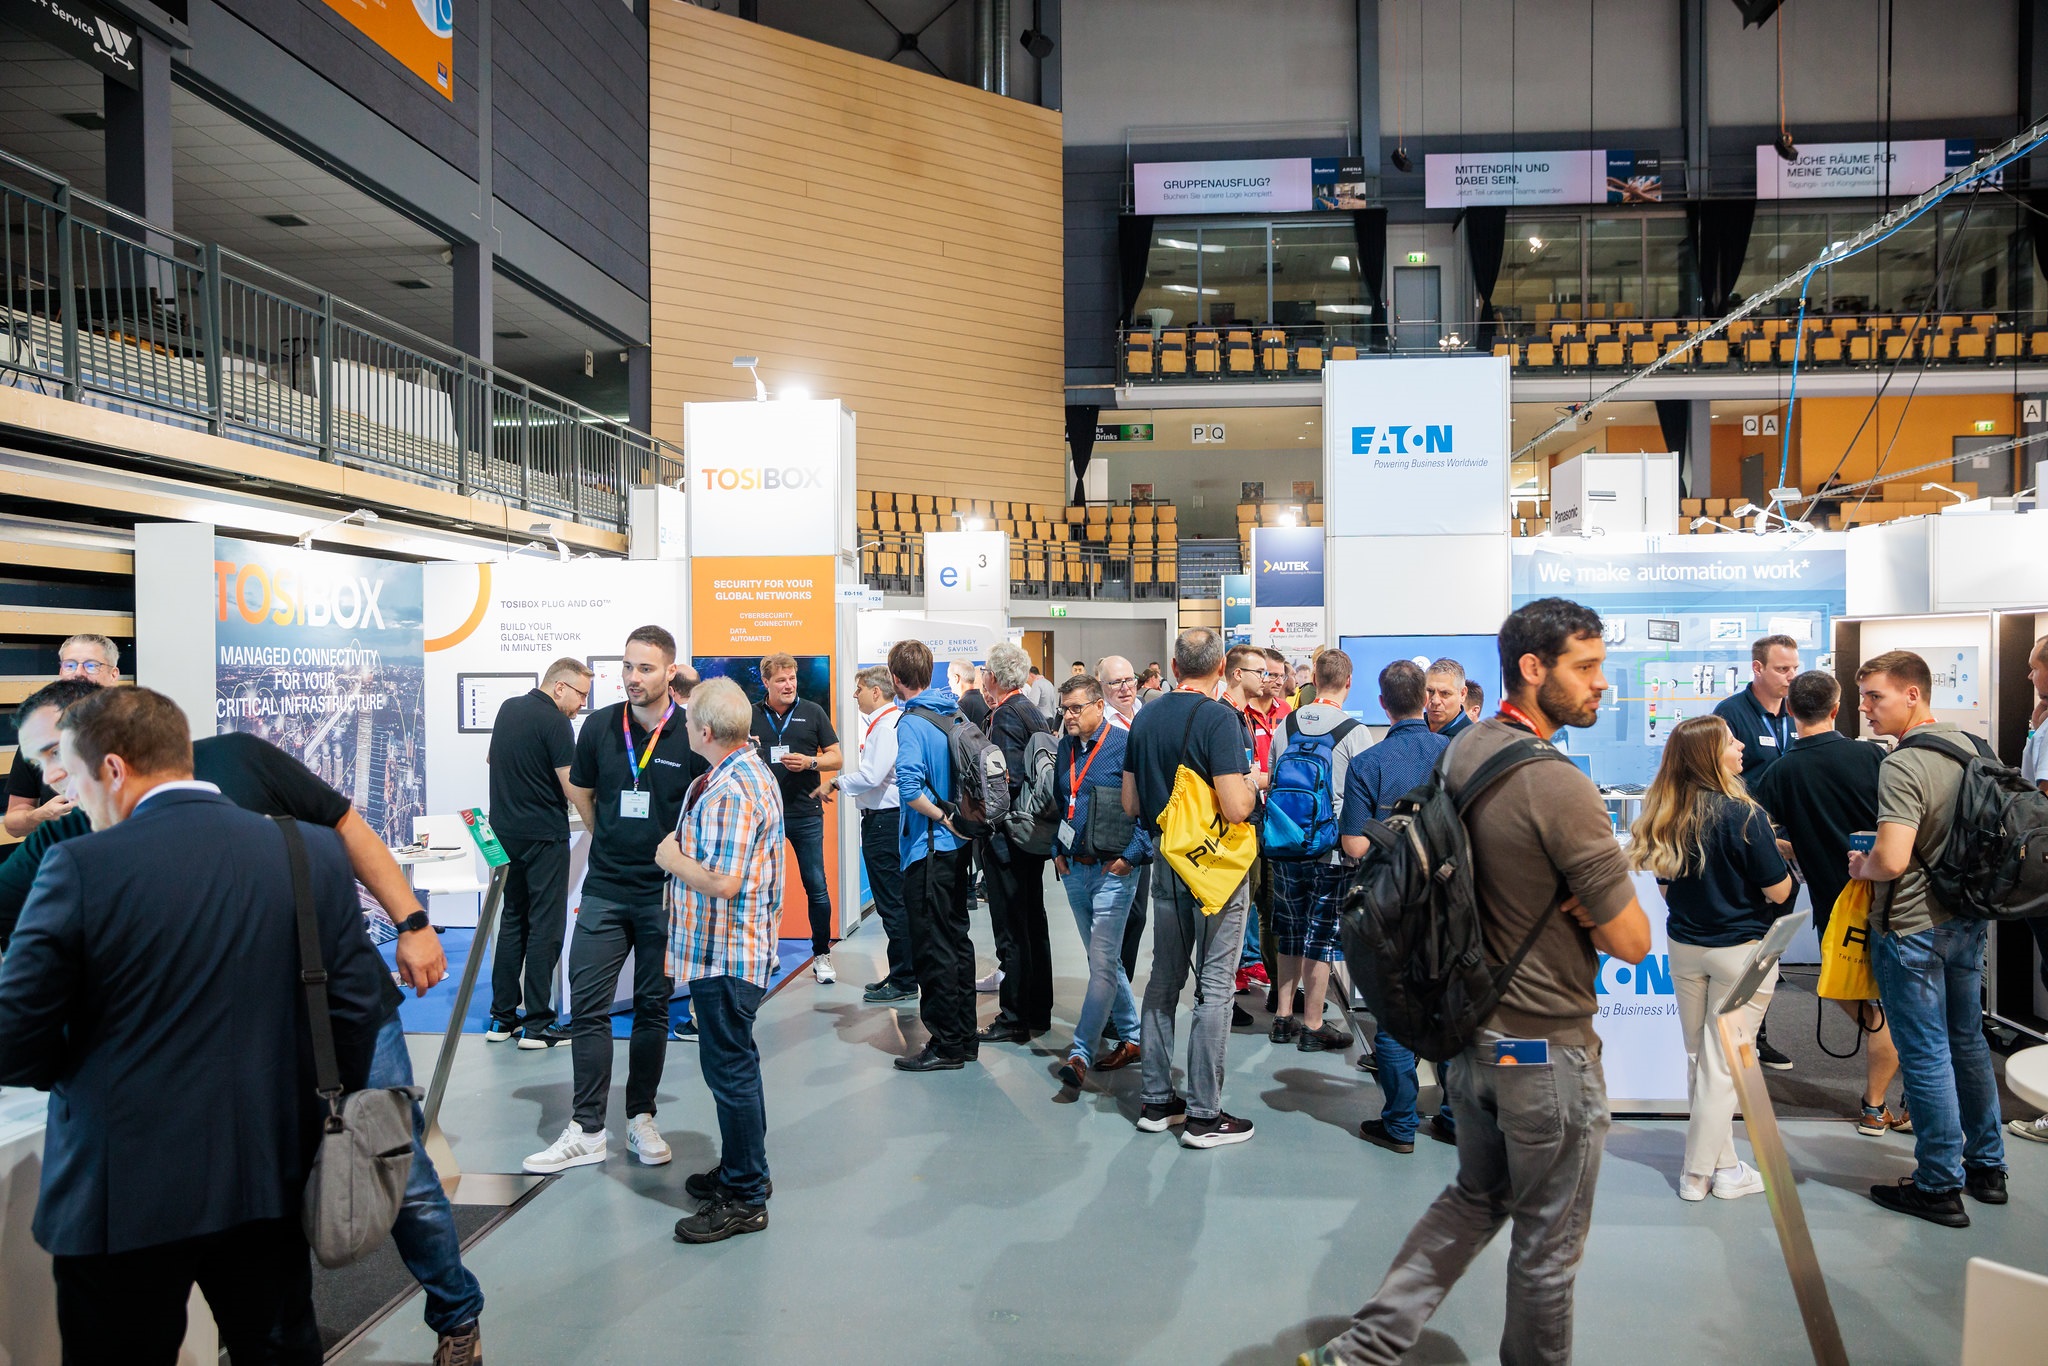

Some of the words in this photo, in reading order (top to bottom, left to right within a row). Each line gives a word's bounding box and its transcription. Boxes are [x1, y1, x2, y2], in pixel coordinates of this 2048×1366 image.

[51, 2, 95, 37] Service
[1829, 153, 1870, 164] RÄUME
[1455, 164, 1522, 174] MITTENDRIN
[1525, 163, 1550, 173] UND
[1787, 167, 1822, 177] MEINE
[1825, 166, 1875, 176] TAGUNG!
[1163, 177, 1271, 190] GRUPPENAUSFLUG?
[1455, 176, 1488, 185] DABEI
[1491, 175, 1520, 185] SEIN.
[1163, 191, 1189, 201] Buchen
[1190, 191, 1201, 199] Sie
[1225, 190, 1243, 200] Loge
[2026, 404, 2039, 418] A
[1744, 418, 1757, 432] Q
[1764, 419, 1776, 432] A
[1095, 433, 1118, 441] Drinks
[1194, 427, 1204, 440] P
[1211, 427, 1225, 440] Q
[1351, 424, 1453, 455] EATON
[1374, 459, 1410, 470] Powering
[1411, 458, 1445, 469] Business
[1446, 457, 1489, 468] Worldwide
[701, 467, 823, 491] TOSIBOX
[1555, 503, 1579, 525] Panasonic
[1271, 561, 1310, 572] AUTEK
[1537, 562, 1571, 583] We
[1577, 561, 1631, 583] make
[1637, 560, 1747, 582] automation
[713, 579, 762, 589] SECURITY
[764, 579, 784, 588] FOR
[785, 579, 813, 588] YOUR
[214, 559, 386, 630] TOSIBOX
[715, 591, 754, 601] GLOBAL
[755, 591, 812, 600] NETWORKS
[500, 600, 539, 609] TOSIBOX
[541, 600, 565, 608] PLUG
[567, 599, 588, 608] AND
[500, 622, 527, 631] BUILD
[528, 622, 552, 631] YOUR
[500, 633, 535, 641] GLOBAL
[536, 632, 582, 641] NETWORK
[500, 643, 510, 652] IN
[511, 643, 553, 652] MINUTES
[220, 645, 290, 666] MANAGED
[292, 648, 378, 666] CONNECTIVITY
[274, 671, 301, 690] FOR
[301, 671, 335, 690] YOUR
[216, 697, 279, 718] CRITICAL
[280, 693, 384, 714] INFRASTRUCTURE
[1612, 1002, 1663, 1016] Business
